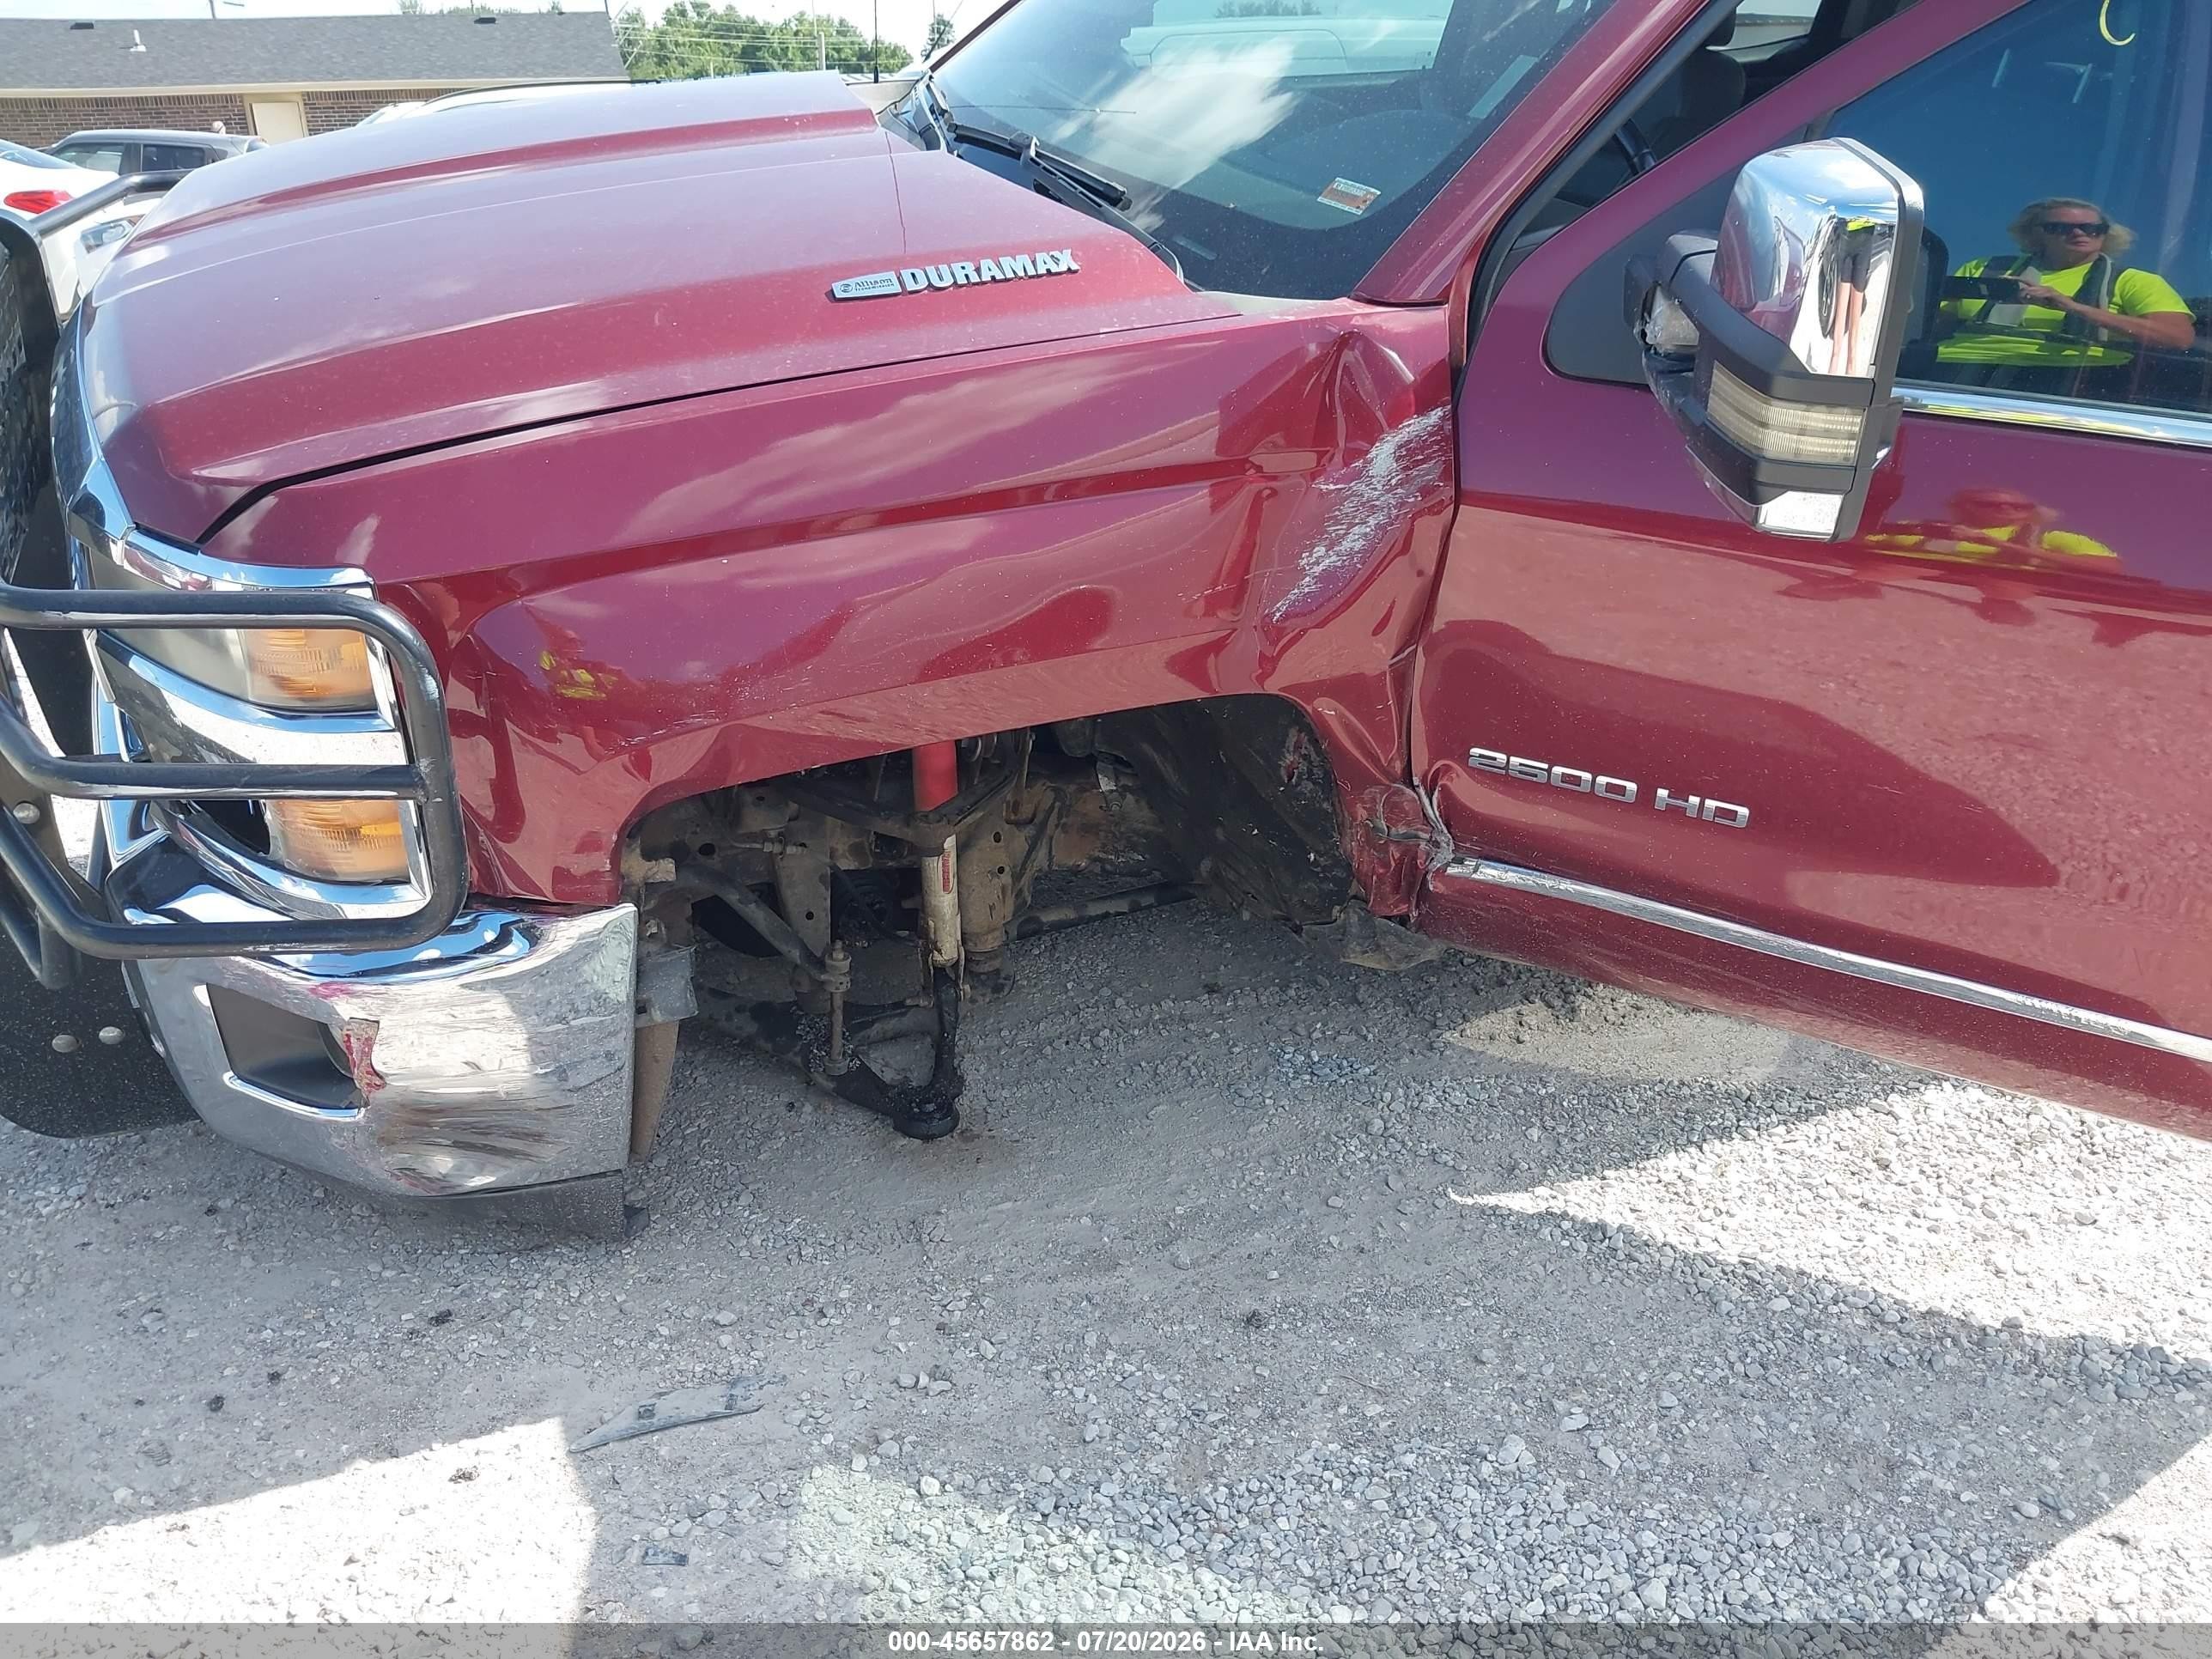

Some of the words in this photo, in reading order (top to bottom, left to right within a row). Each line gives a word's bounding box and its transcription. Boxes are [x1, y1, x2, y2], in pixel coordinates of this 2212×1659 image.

[854, 277, 893, 289] Allison
[900, 249, 1080, 293] DURAMAX
[1468, 747, 1638, 804] 2500
[1655, 787, 1750, 829] HD
